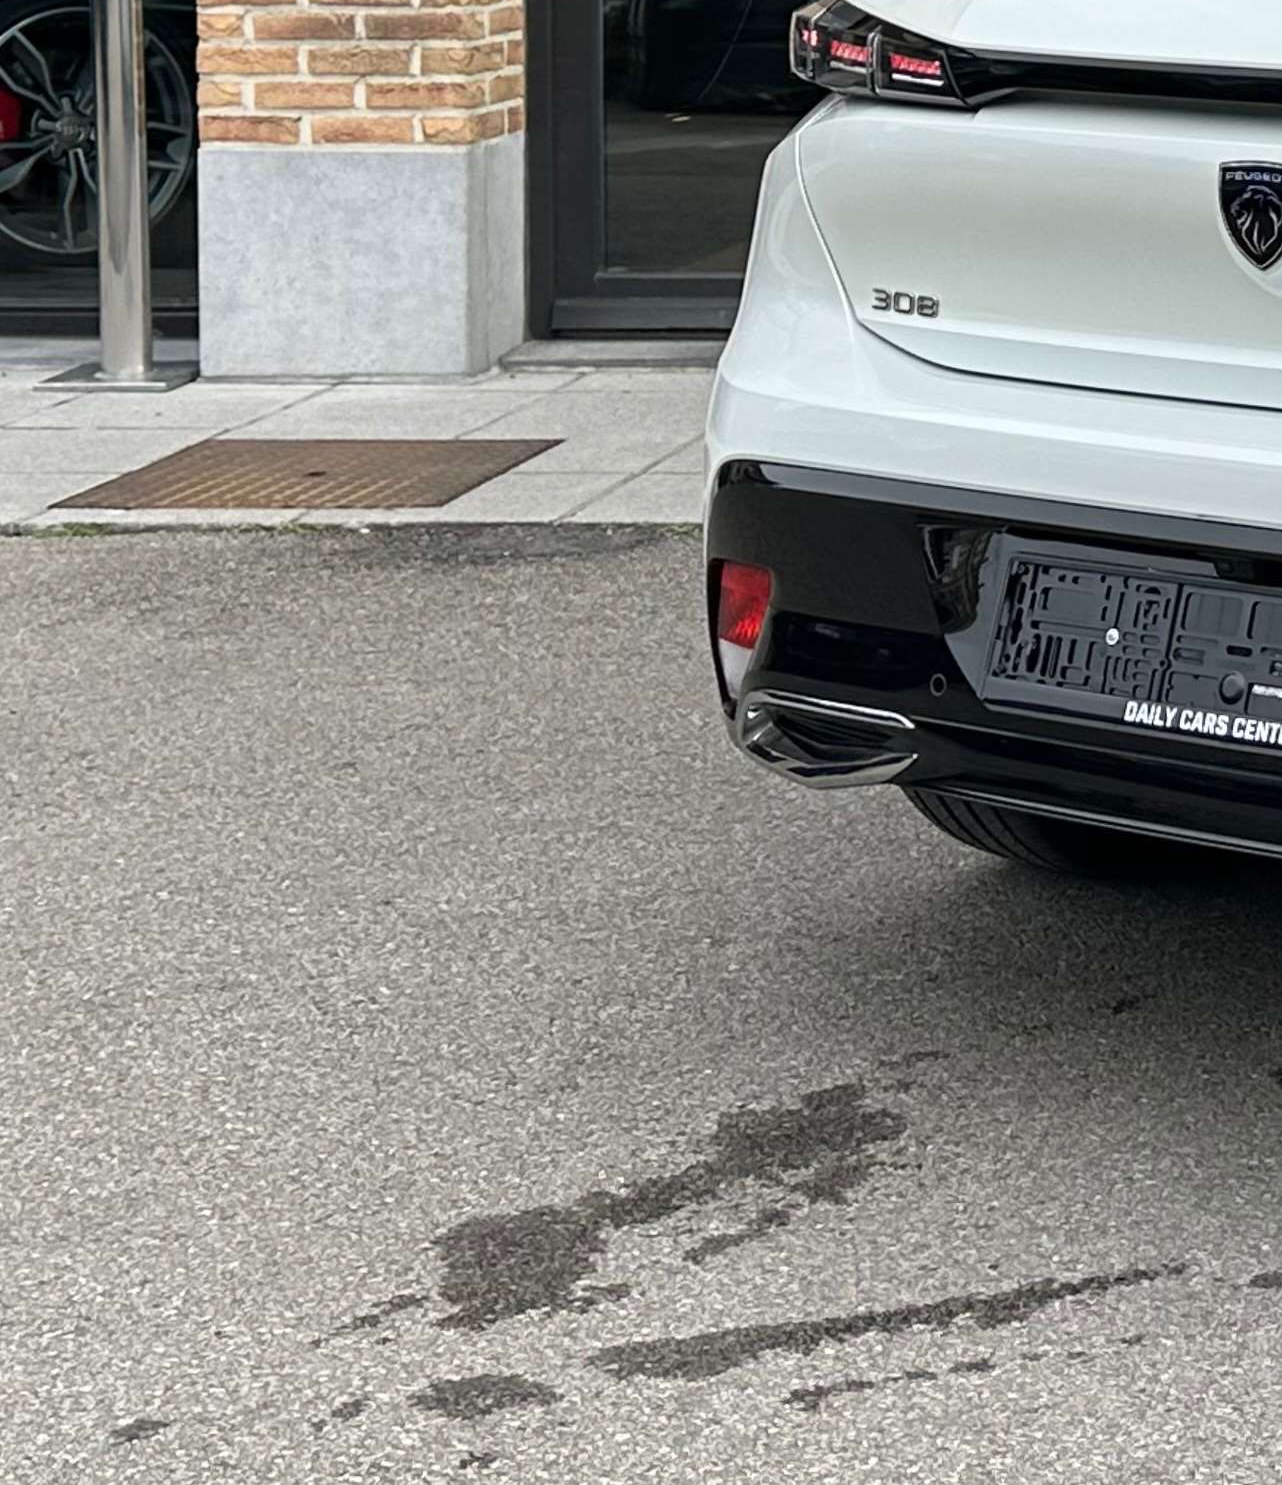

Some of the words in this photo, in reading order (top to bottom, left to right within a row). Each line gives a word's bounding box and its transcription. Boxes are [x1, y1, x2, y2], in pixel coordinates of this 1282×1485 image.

[871, 287, 940, 319] 308
[1123, 700, 1178, 728] DAILY
[1179, 709, 1230, 736] CARS
